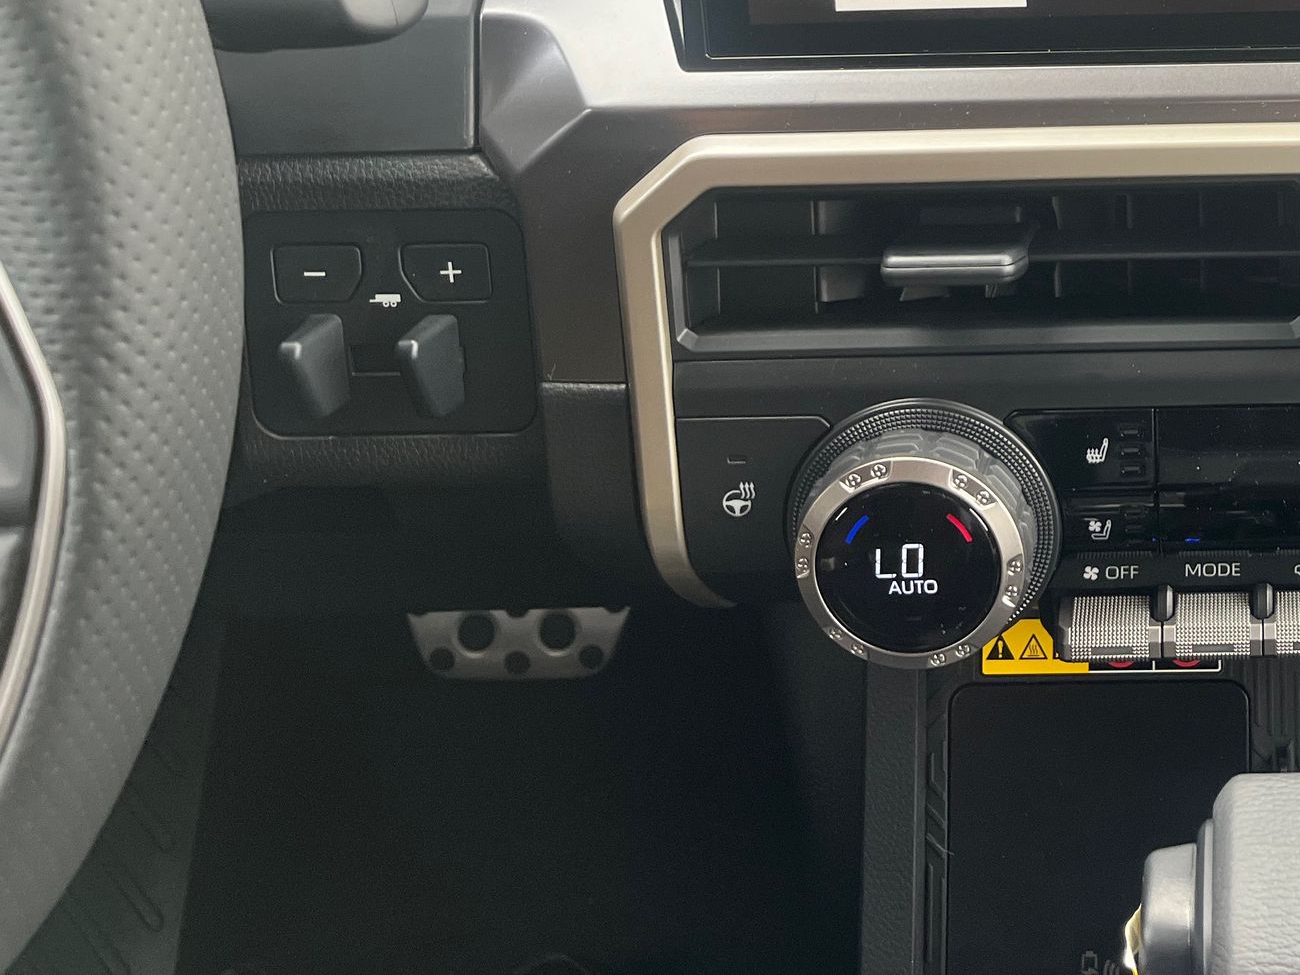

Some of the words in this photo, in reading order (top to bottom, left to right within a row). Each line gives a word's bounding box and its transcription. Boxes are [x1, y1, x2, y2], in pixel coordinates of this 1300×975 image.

[1106, 566, 1139, 580] OFF
[1185, 563, 1241, 577] MODE
[889, 580, 938, 595] AUTO
